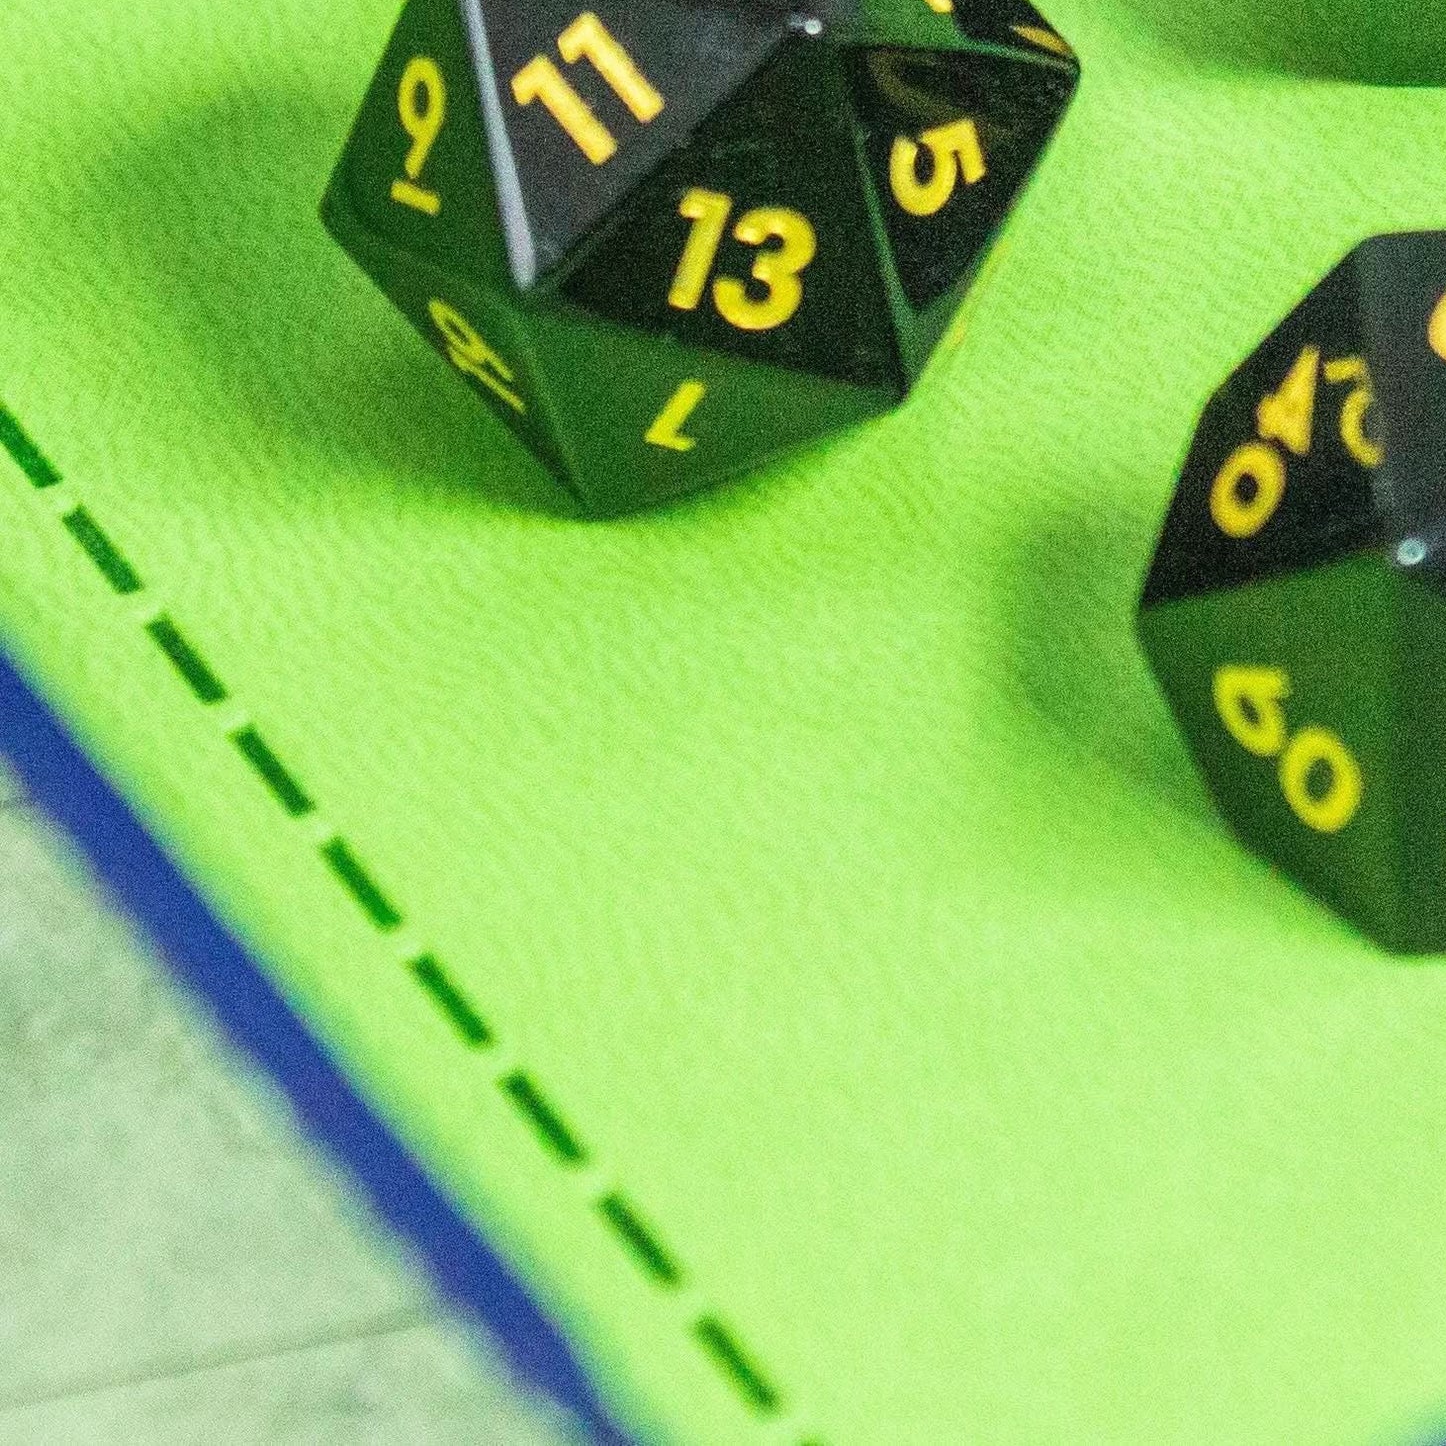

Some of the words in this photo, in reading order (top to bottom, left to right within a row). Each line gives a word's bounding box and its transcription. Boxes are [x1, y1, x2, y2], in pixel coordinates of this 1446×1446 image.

[510, 12, 664, 166] 11
[888, 117, 988, 218] 5
[666, 187, 818, 332] 13
[1209, 342, 1322, 538] 40
